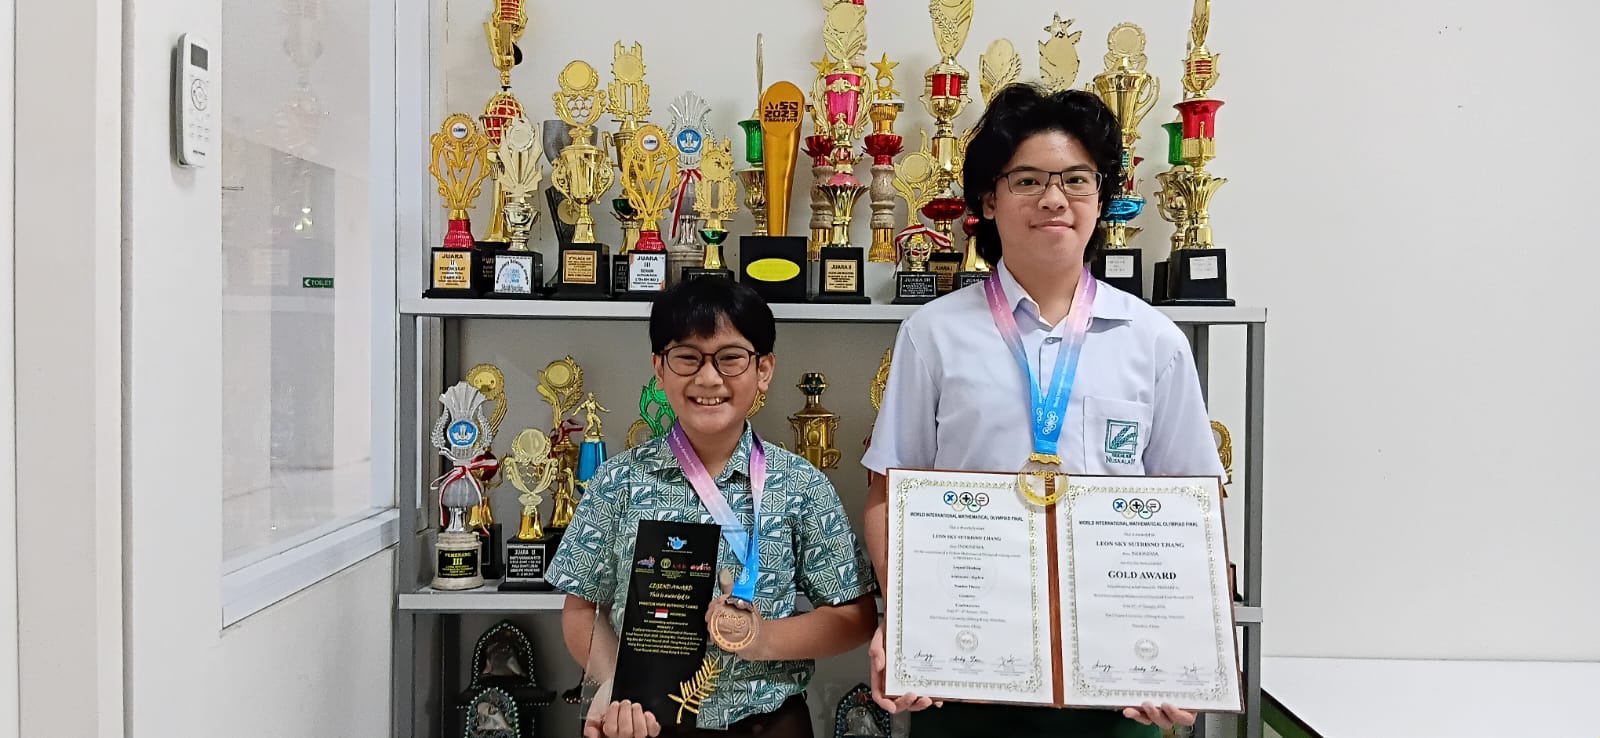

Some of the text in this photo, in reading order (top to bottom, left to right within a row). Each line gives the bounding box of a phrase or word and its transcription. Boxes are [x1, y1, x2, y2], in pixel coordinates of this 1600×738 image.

[764, 110, 799, 118] 2023
[452, 557, 463, 566] III
[1107, 570, 1177, 581] GOLD AWARD
